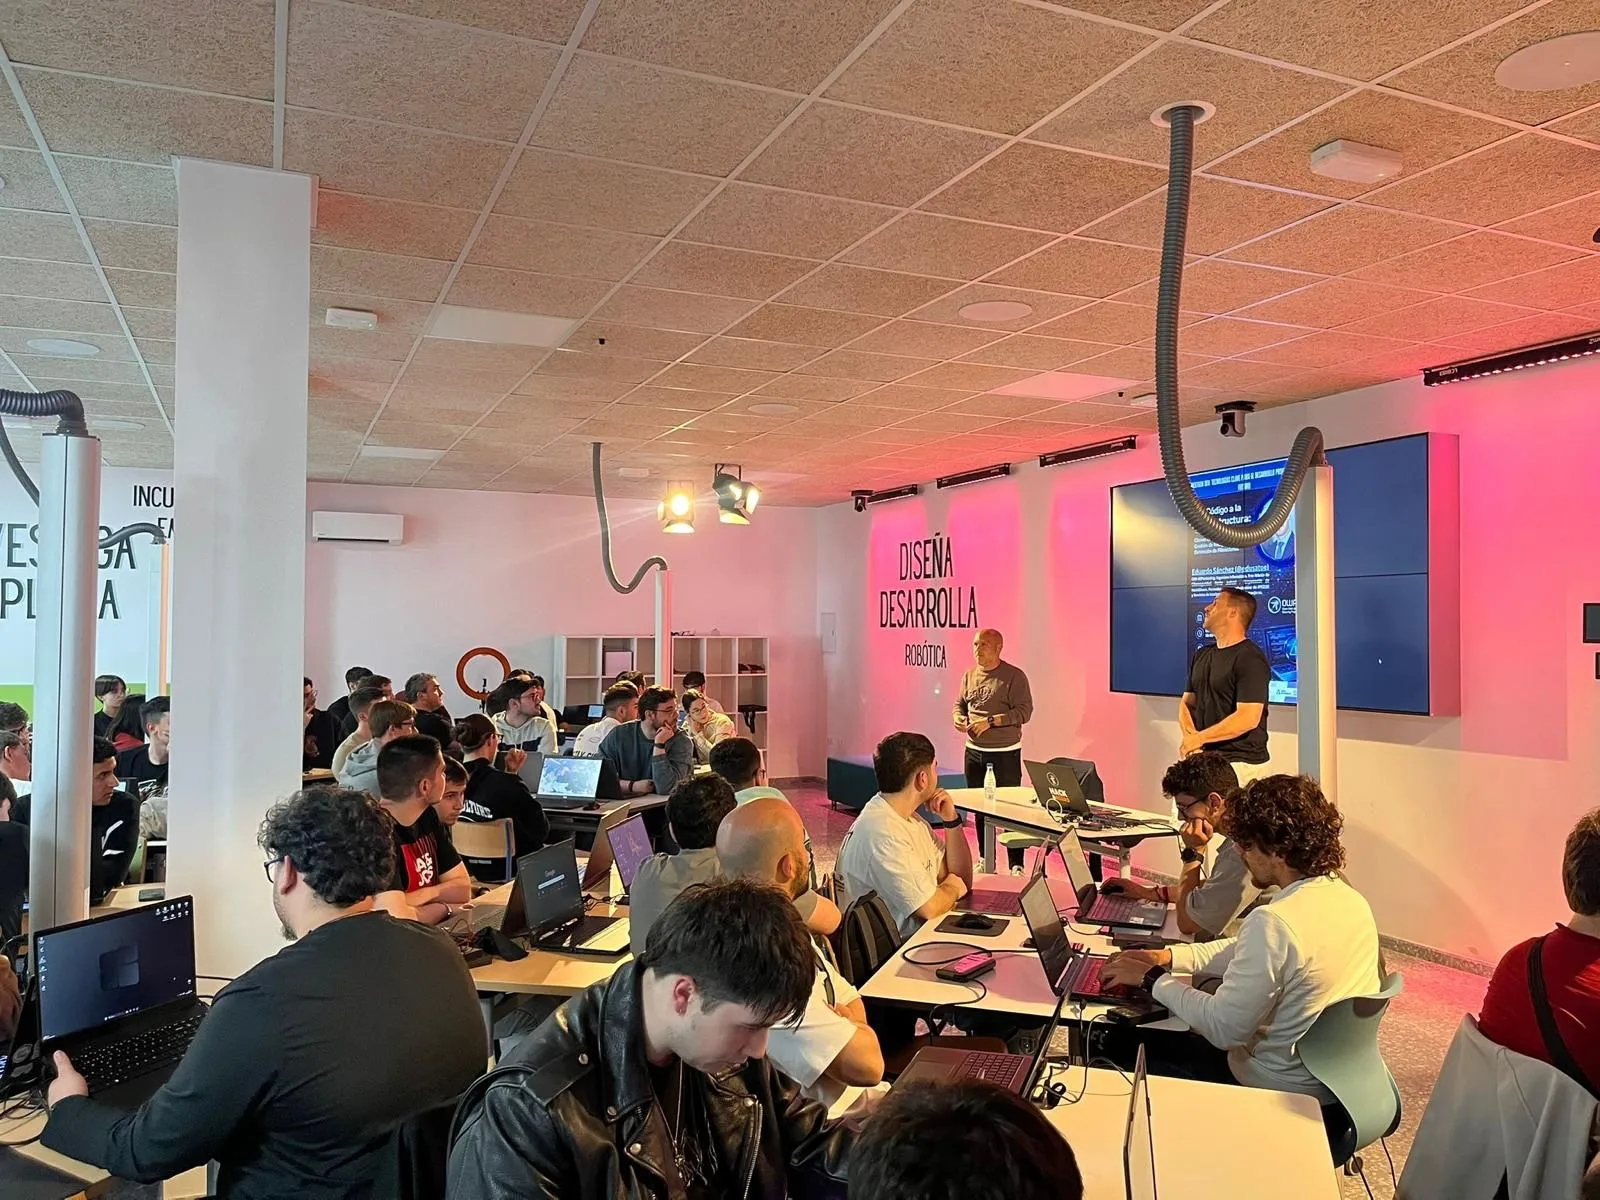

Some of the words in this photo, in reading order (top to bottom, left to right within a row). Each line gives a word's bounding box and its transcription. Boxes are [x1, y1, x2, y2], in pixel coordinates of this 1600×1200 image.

[1235, 503, 1242, 512] la
[900, 532, 953, 580] DISEÑA
[880, 586, 978, 628] DESARROLLA
[905, 640, 947, 668] ROBÓTICA
